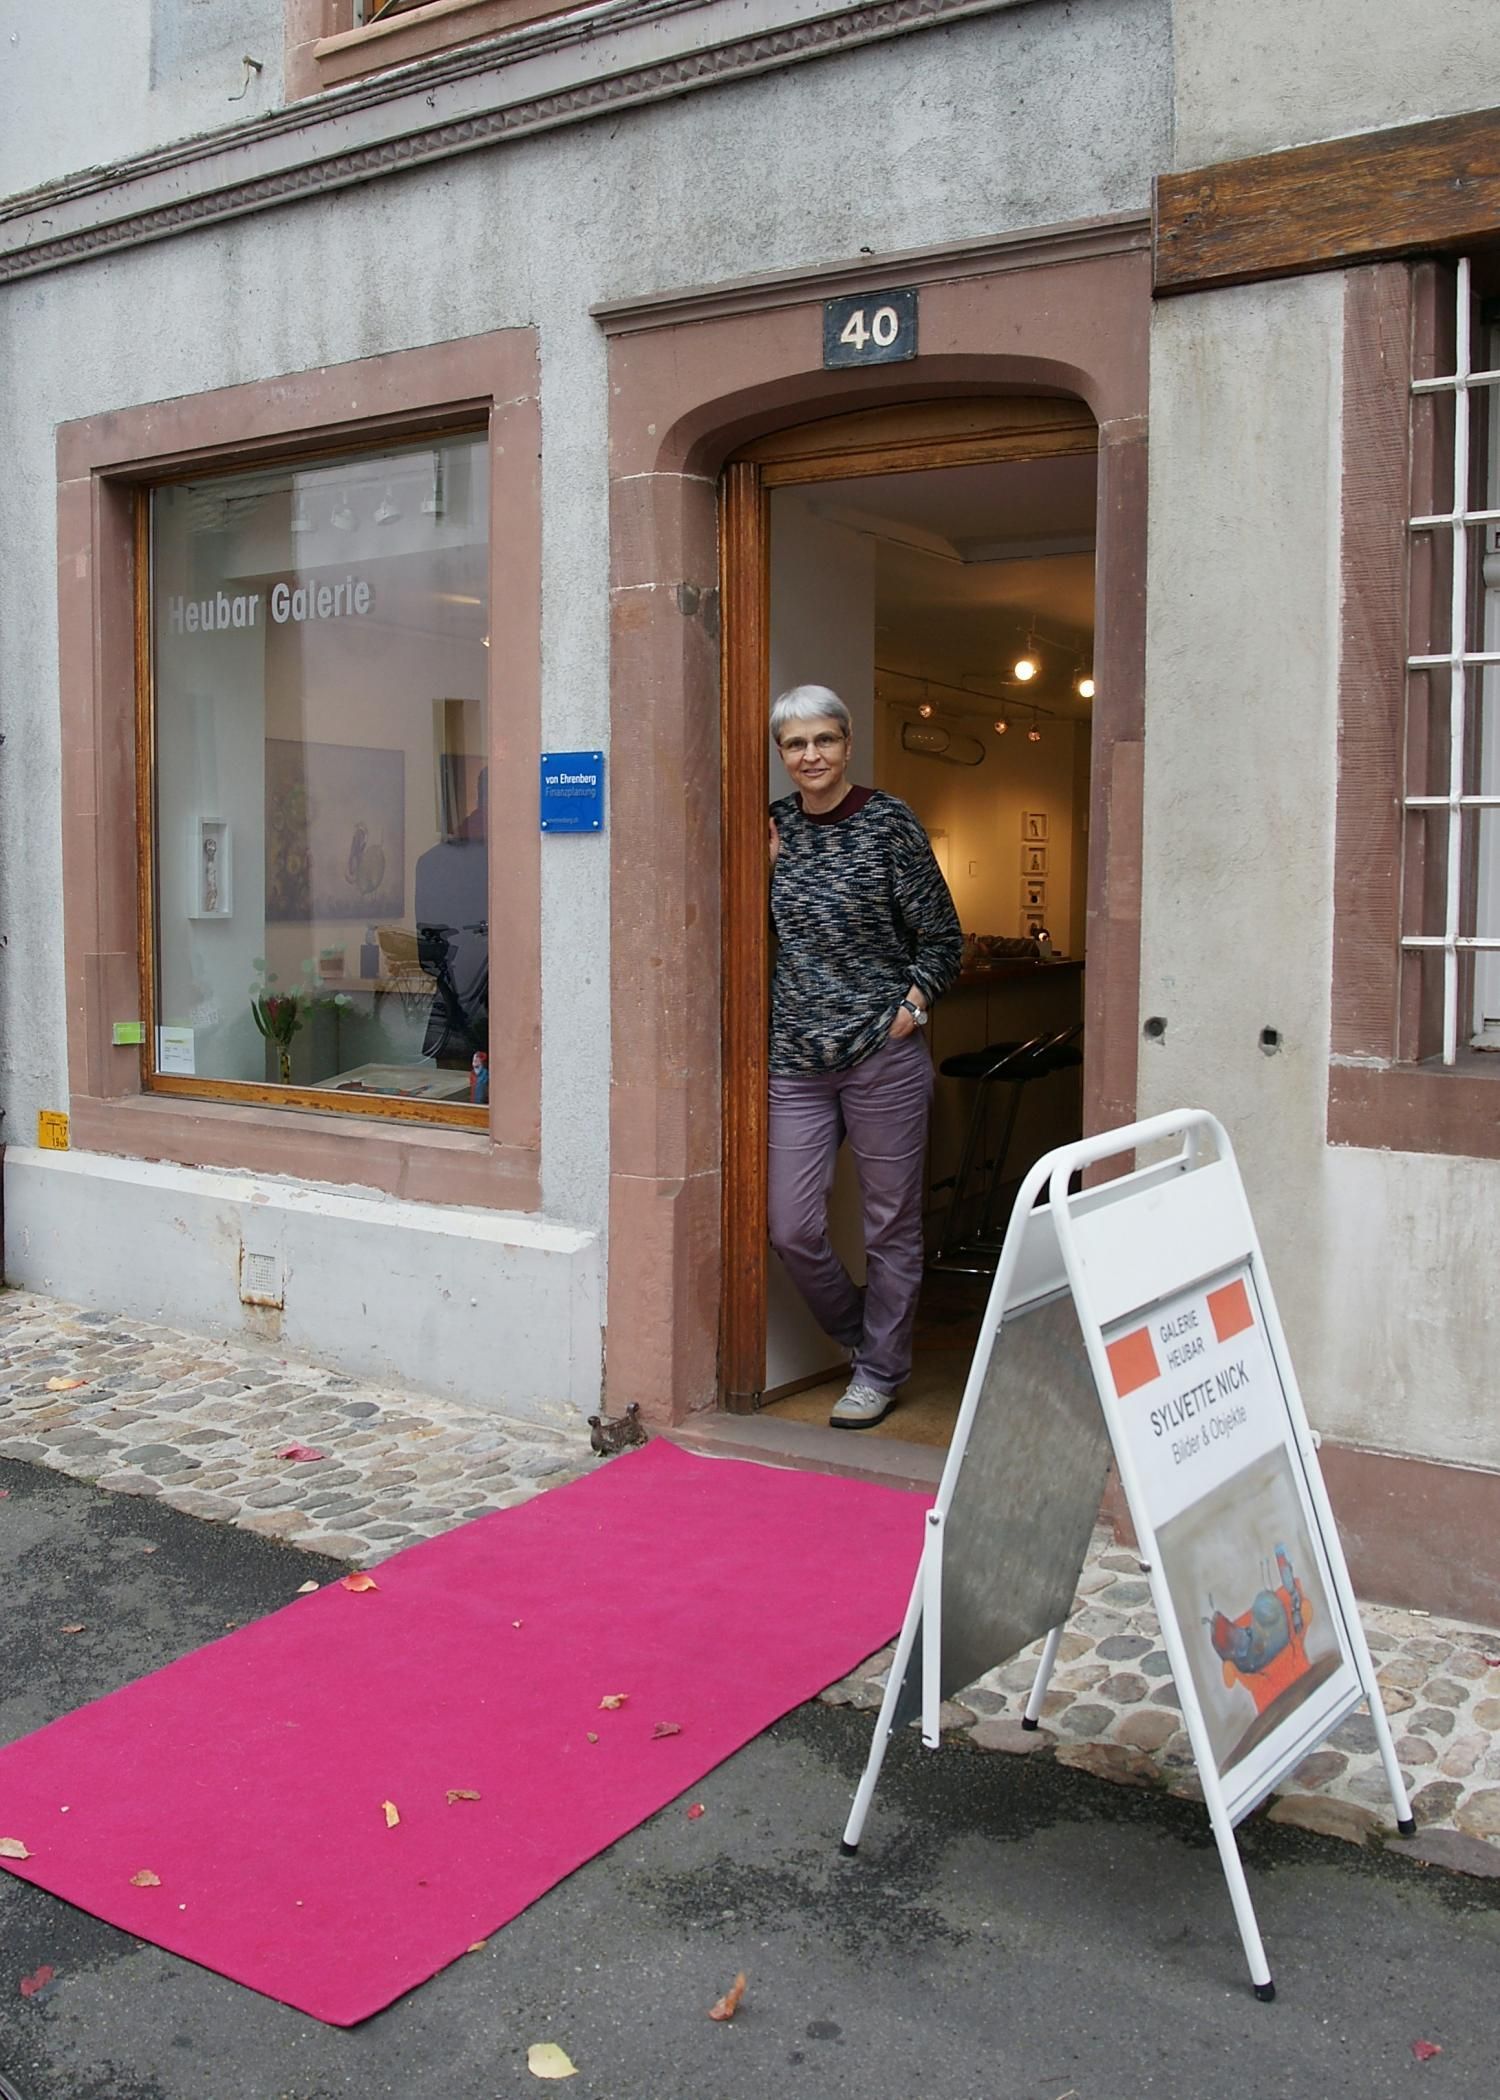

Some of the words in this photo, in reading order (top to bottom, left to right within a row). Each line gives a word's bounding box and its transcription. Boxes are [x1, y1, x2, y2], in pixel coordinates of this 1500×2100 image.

[840, 306, 899, 350] 40
[168, 591, 259, 635] Heubar
[271, 576, 370, 624] Galerie
[545, 776, 559, 785] von
[560, 773, 597, 786] Ehrenberg
[545, 786, 597, 799] Finanzplanung
[1159, 1309, 1200, 1344] GALERIE
[1166, 1336, 1206, 1370] HEUBAR
[1150, 1379, 1216, 1437] SYLVETTE
[1215, 1359, 1250, 1396] NICK
[1171, 1434, 1201, 1465] Bilder
[1201, 1425, 1211, 1446] &
[1209, 1405, 1248, 1440] Objekte
